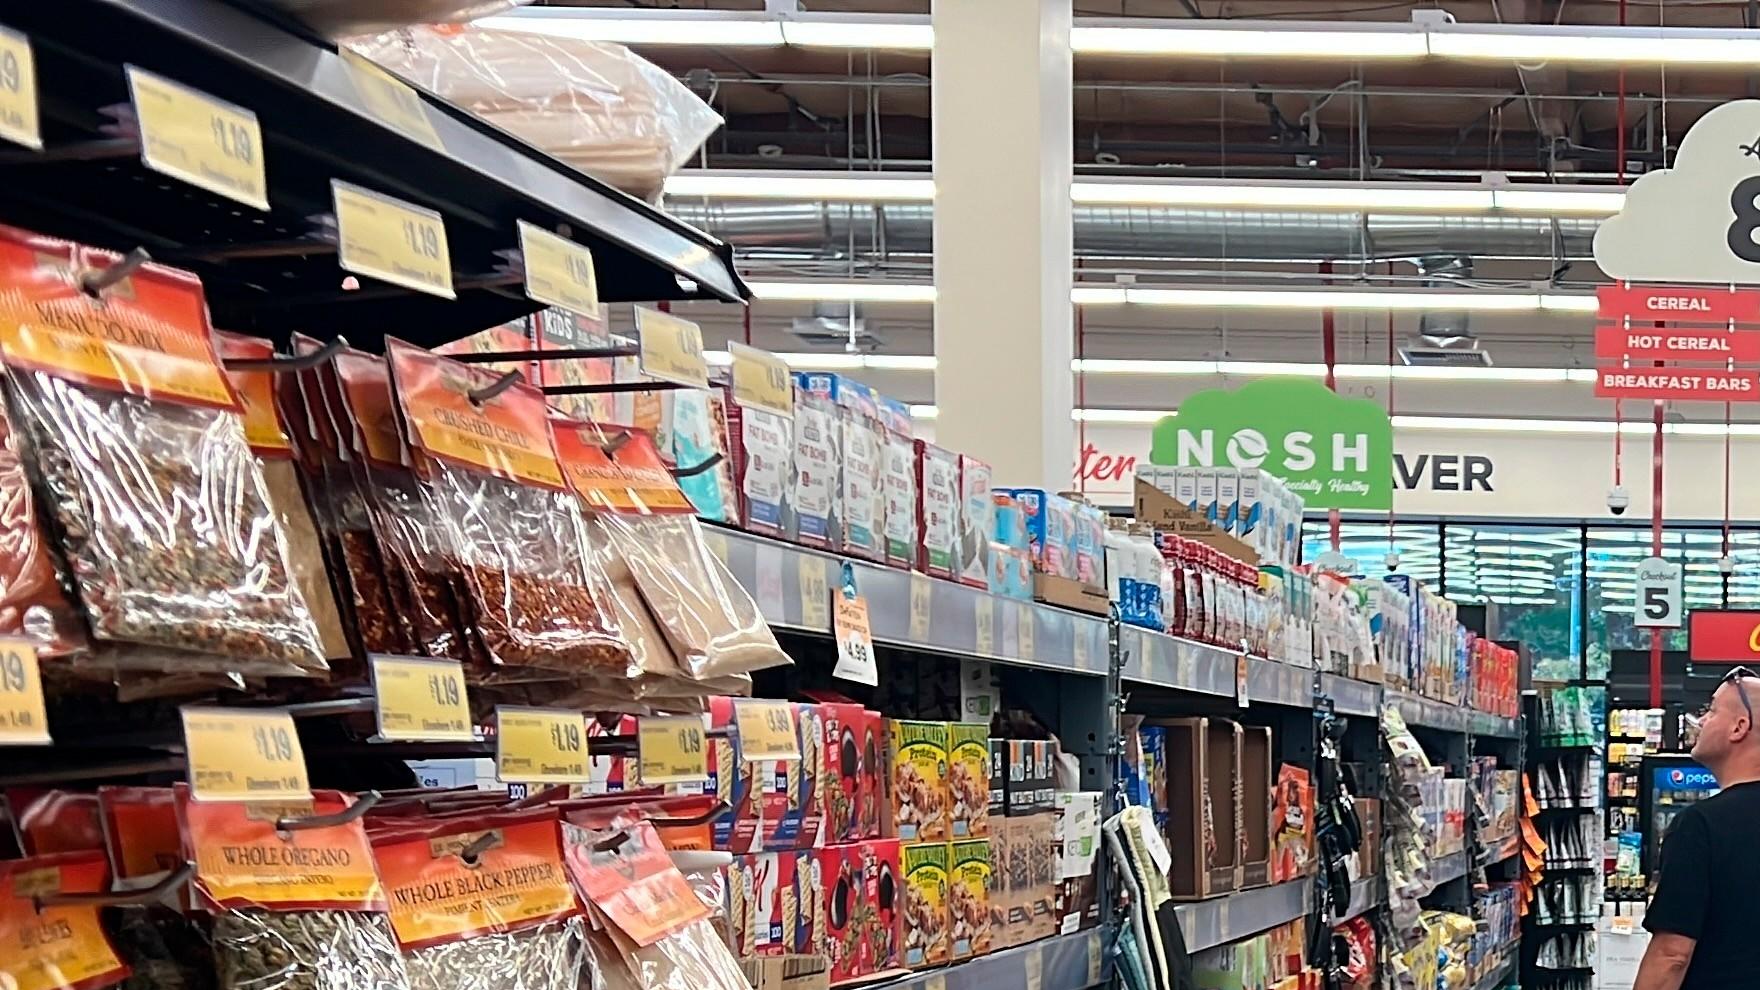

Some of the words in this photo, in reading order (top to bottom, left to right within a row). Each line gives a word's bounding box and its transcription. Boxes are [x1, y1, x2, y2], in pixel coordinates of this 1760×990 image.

[1647, 297, 1711, 311] CEREAL
[1628, 336, 1662, 349] HOT
[1667, 337, 1730, 351] CEREAL
[1604, 374, 1700, 390] BREAKFAST
[1707, 377, 1750, 391] BARS
[1178, 429, 1369, 472] NOSH
[1074, 443, 1135, 482] ter
[1644, 587, 1670, 620] 5
[1685, 771, 1717, 785] peps
[222, 846, 279, 866] WHOLE
[281, 848, 350, 867] OREGANO
[394, 884, 452, 908] WHOLE
[457, 872, 504, 896] BLACK
[506, 863, 553, 888] PEPPER
